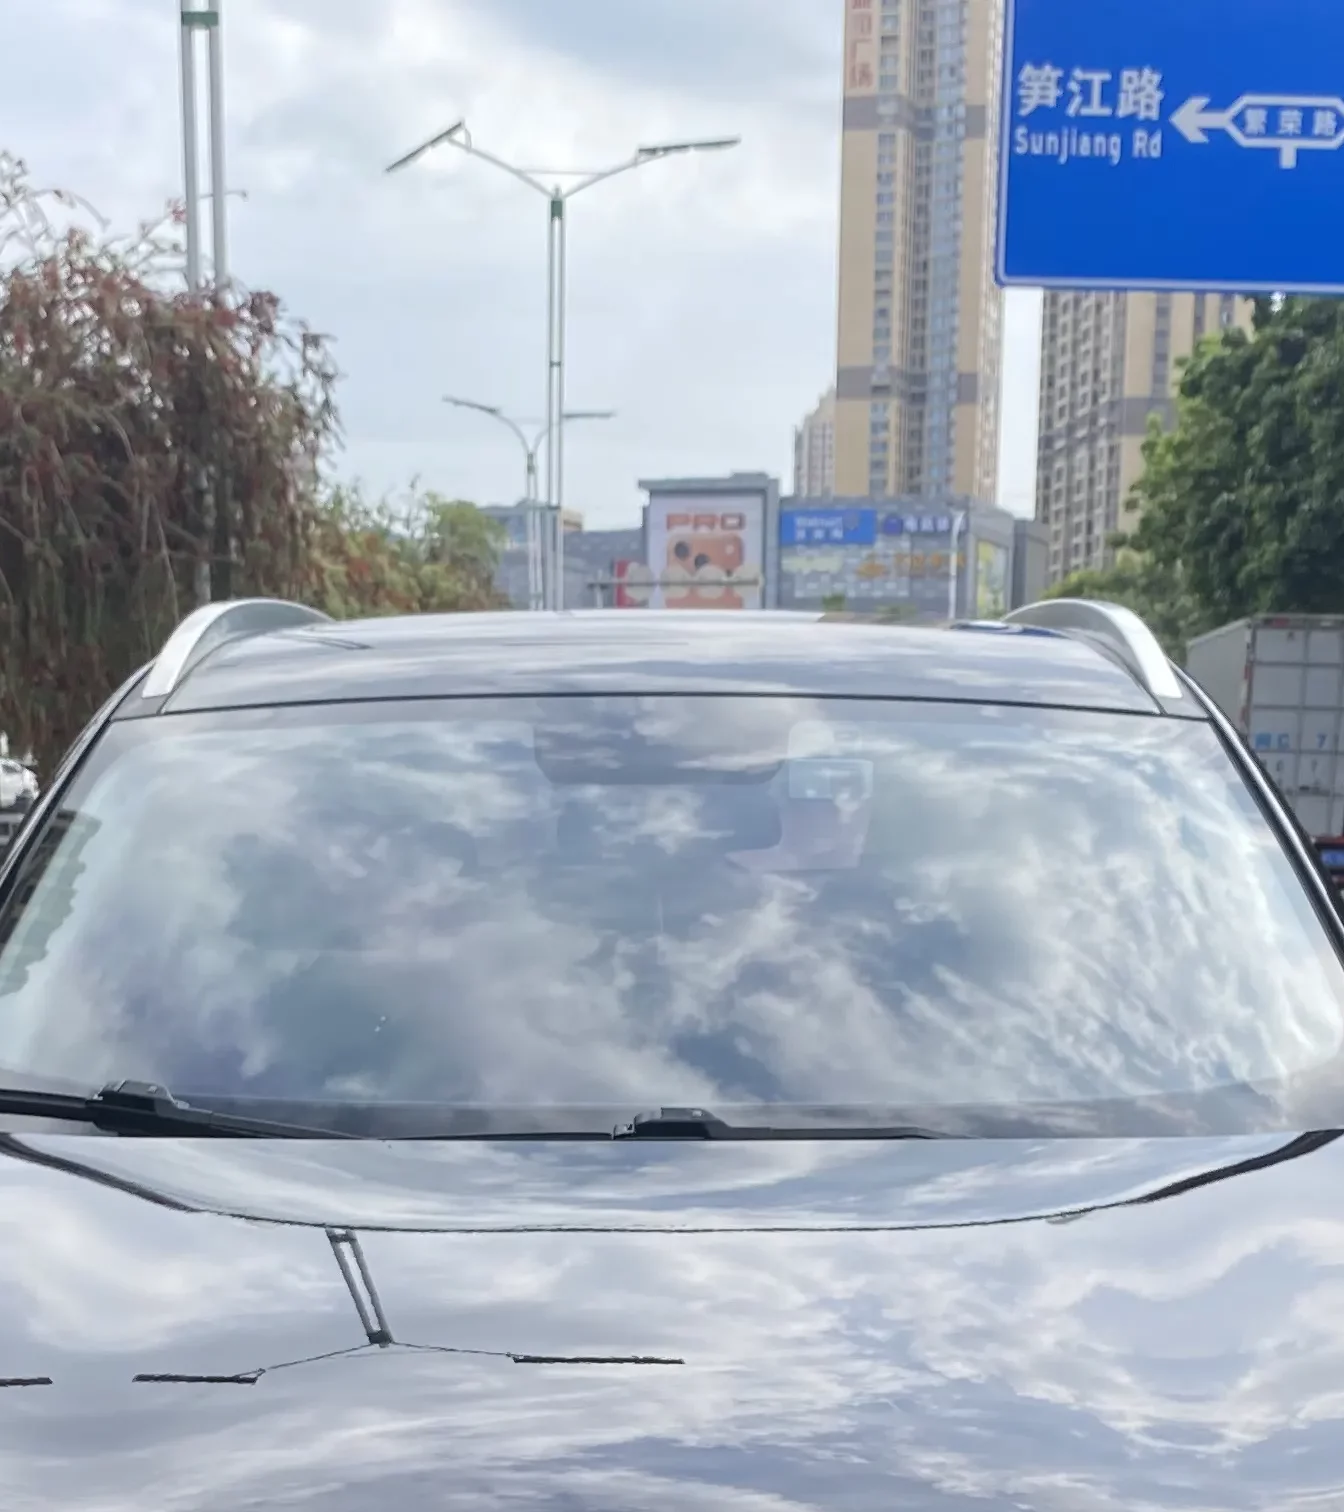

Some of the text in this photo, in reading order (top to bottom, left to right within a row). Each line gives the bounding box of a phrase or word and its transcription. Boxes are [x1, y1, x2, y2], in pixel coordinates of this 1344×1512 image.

[1017, 62, 1165, 120] 笋江路
[1014, 126, 1163, 166] Sunjiang Rd
